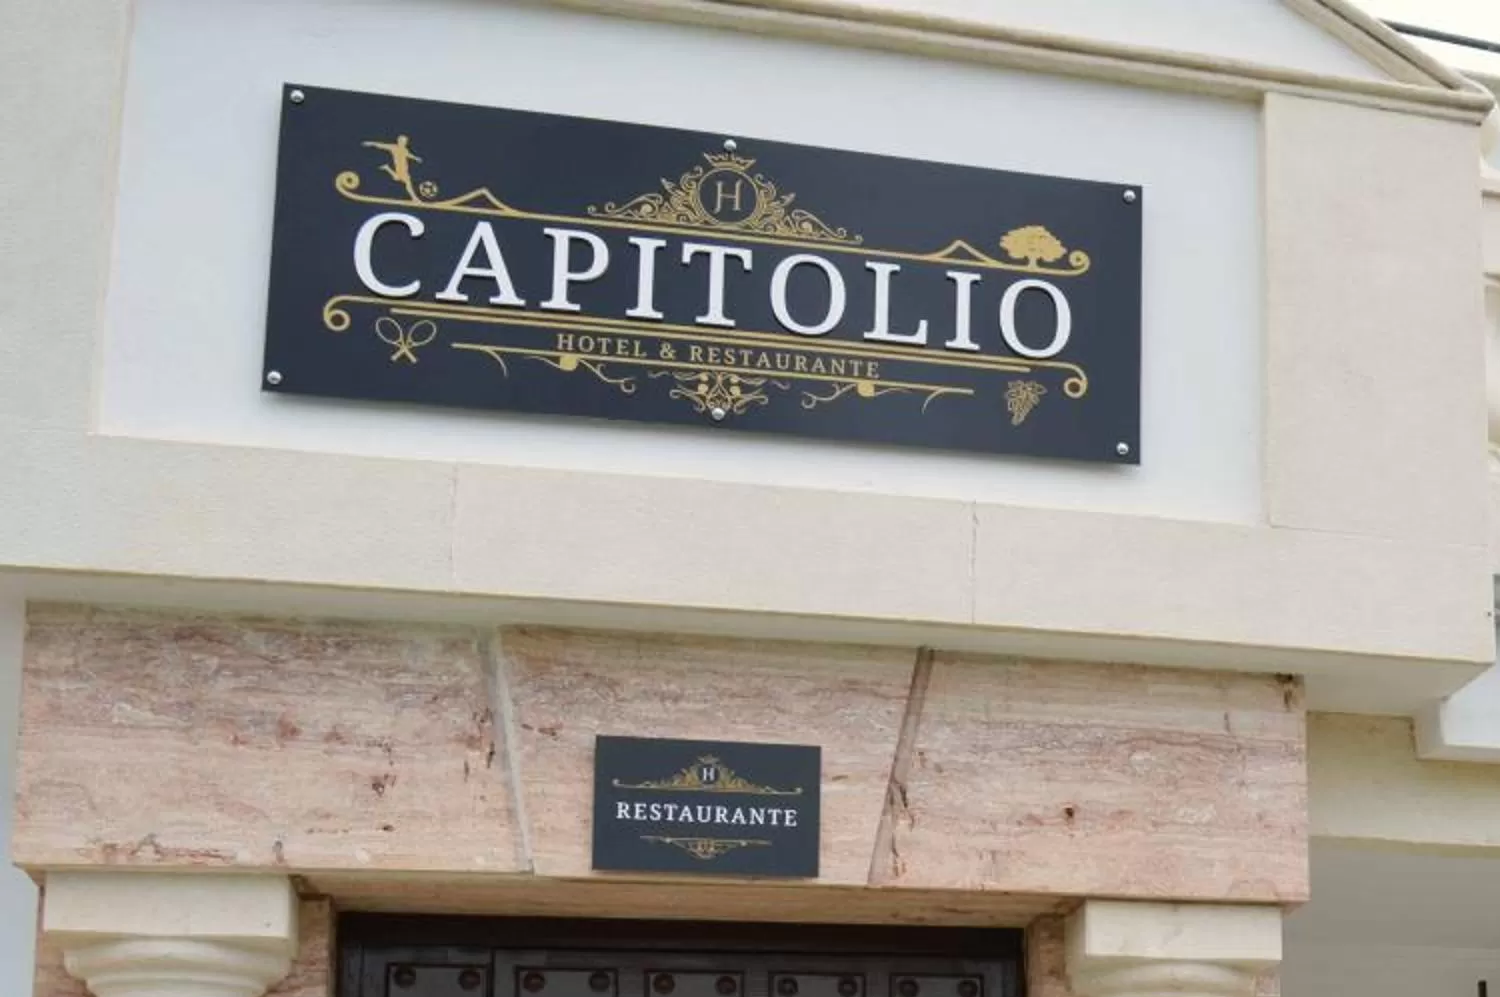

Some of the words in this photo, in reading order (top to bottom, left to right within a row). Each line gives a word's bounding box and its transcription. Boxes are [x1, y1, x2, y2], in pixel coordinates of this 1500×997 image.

[352, 210, 1073, 359] CAPITOLIO
[556, 333, 648, 358] HOTEL
[659, 342, 677, 360] &
[690, 344, 881, 379] RESTAURANTE
[616, 801, 798, 827] RESTAURANTE
